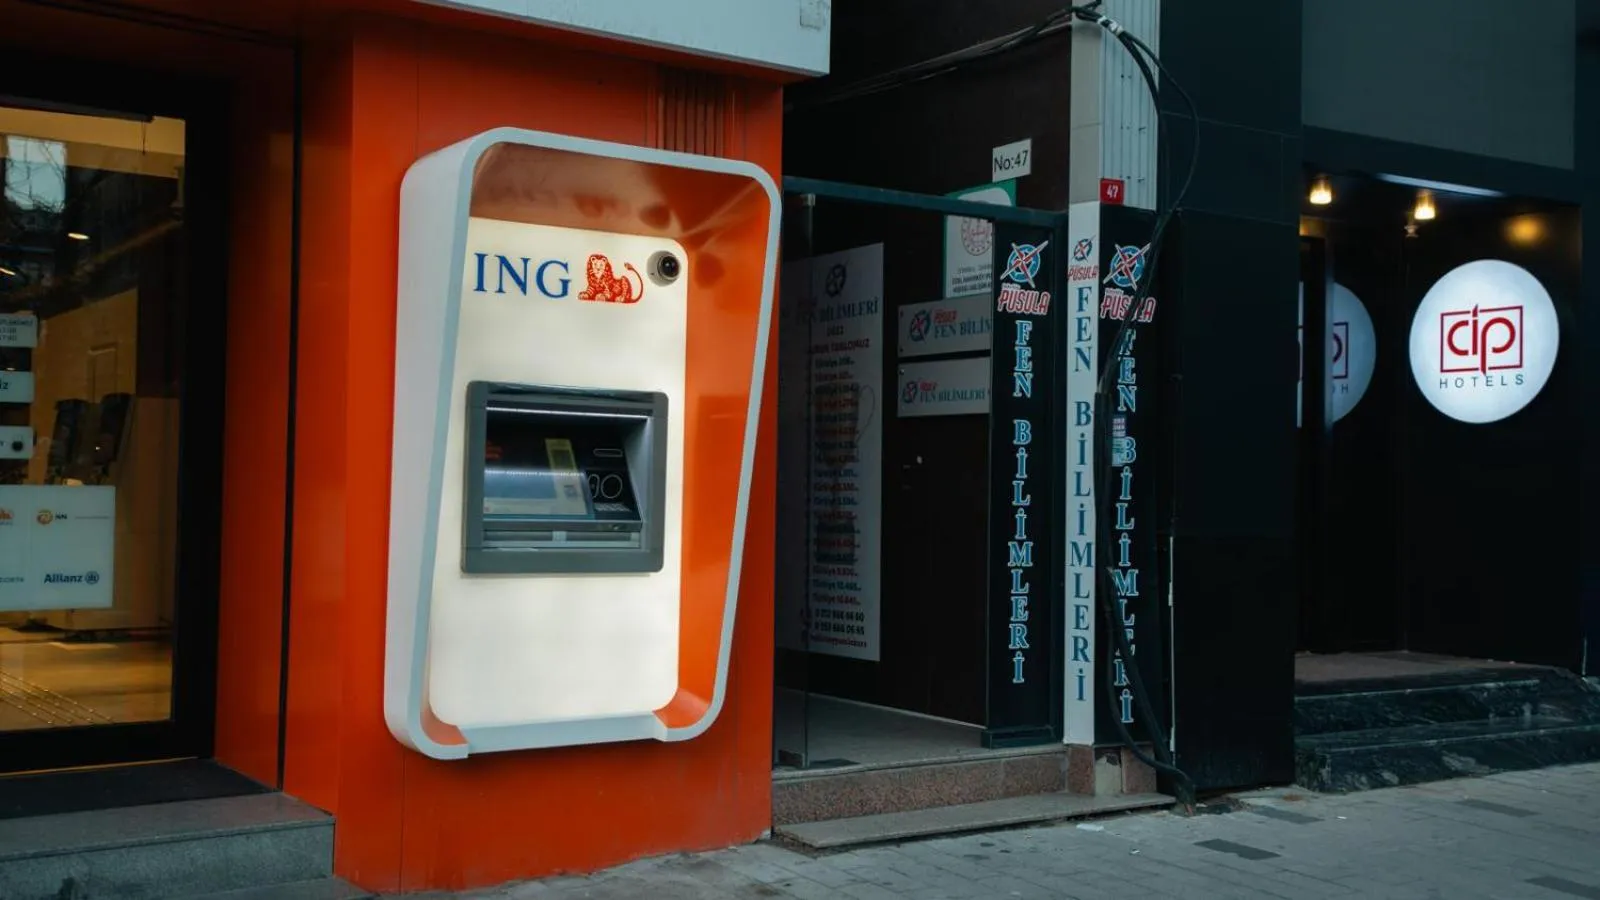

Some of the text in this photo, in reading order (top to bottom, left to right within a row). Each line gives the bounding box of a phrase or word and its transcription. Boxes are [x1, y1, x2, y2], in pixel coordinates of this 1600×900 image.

[993, 152, 1029, 173] No:47
[1107, 184, 1119, 199] 47
[473, 252, 572, 299] ING
[998, 289, 1050, 315] PUSULA
[1100, 296, 1156, 322] PUSLA
[1439, 374, 1524, 389] HOTELS
[1008, 319, 1034, 684] FEN BİLİMLERİ
[1069, 286, 1094, 702] FEN BİLİMLERİ
[44, 572, 83, 584] Allianz
[1112, 436, 1140, 724] BİLİMLRİ
